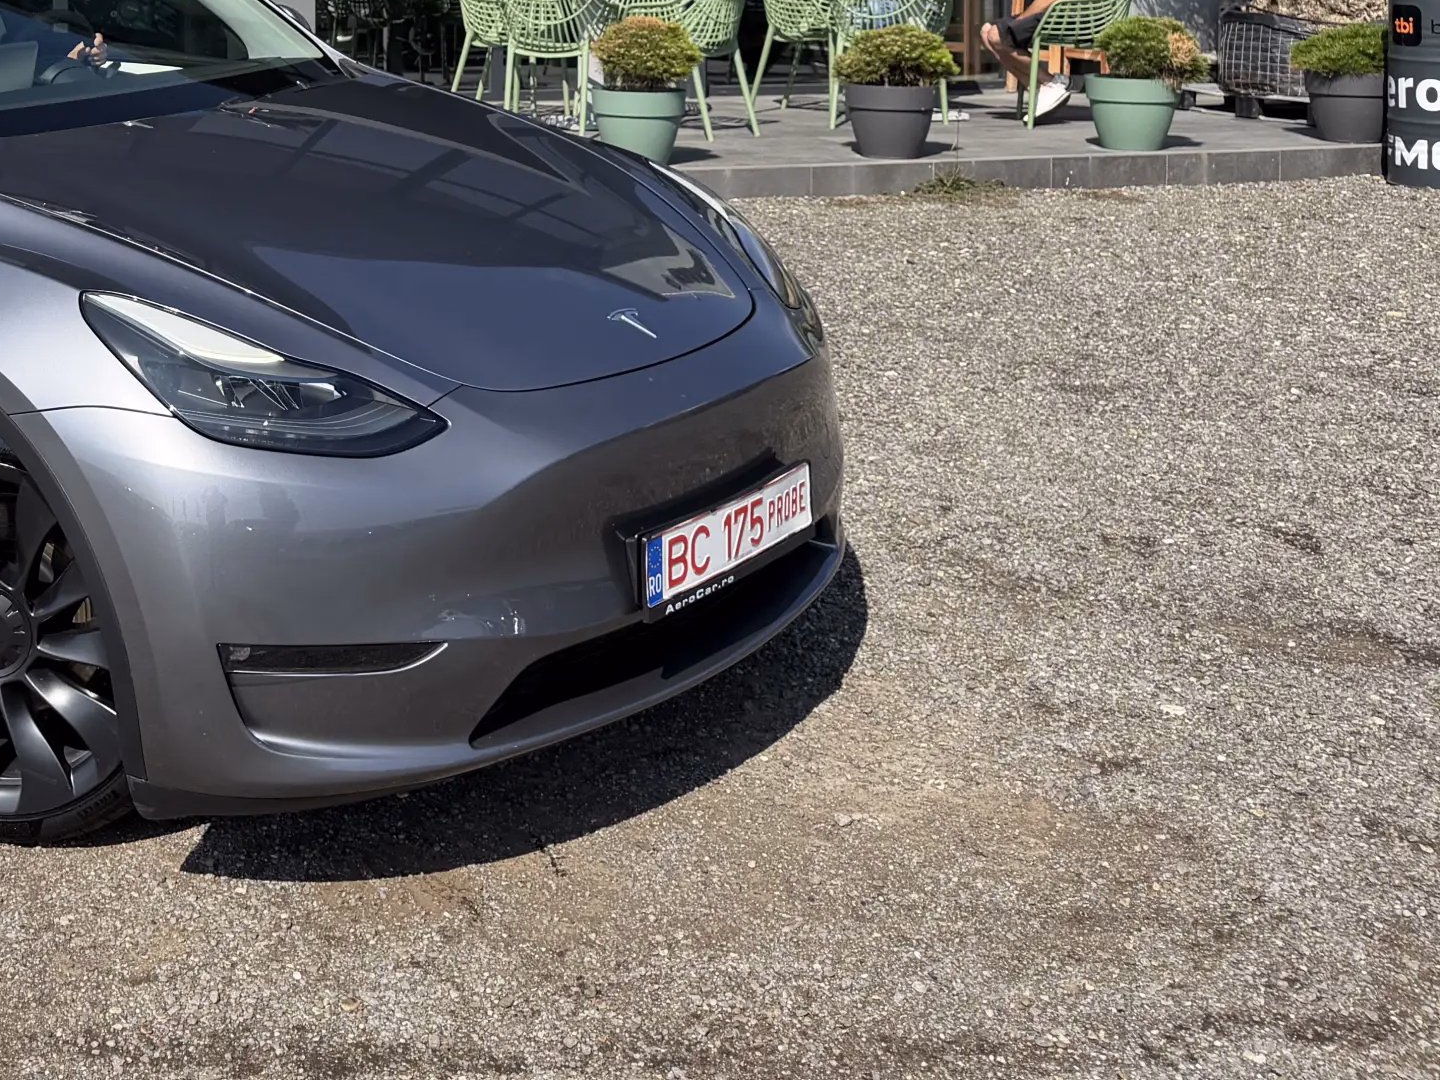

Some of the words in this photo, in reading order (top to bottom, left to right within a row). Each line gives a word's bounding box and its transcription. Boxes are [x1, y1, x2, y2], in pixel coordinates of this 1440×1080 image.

[1394, 16, 1414, 35] tbi
[667, 524, 711, 590] BC
[722, 496, 765, 562] 175
[767, 480, 806, 533] PROBE
[648, 572, 662, 598] RO
[665, 575, 735, 615] AeroCar.ro
